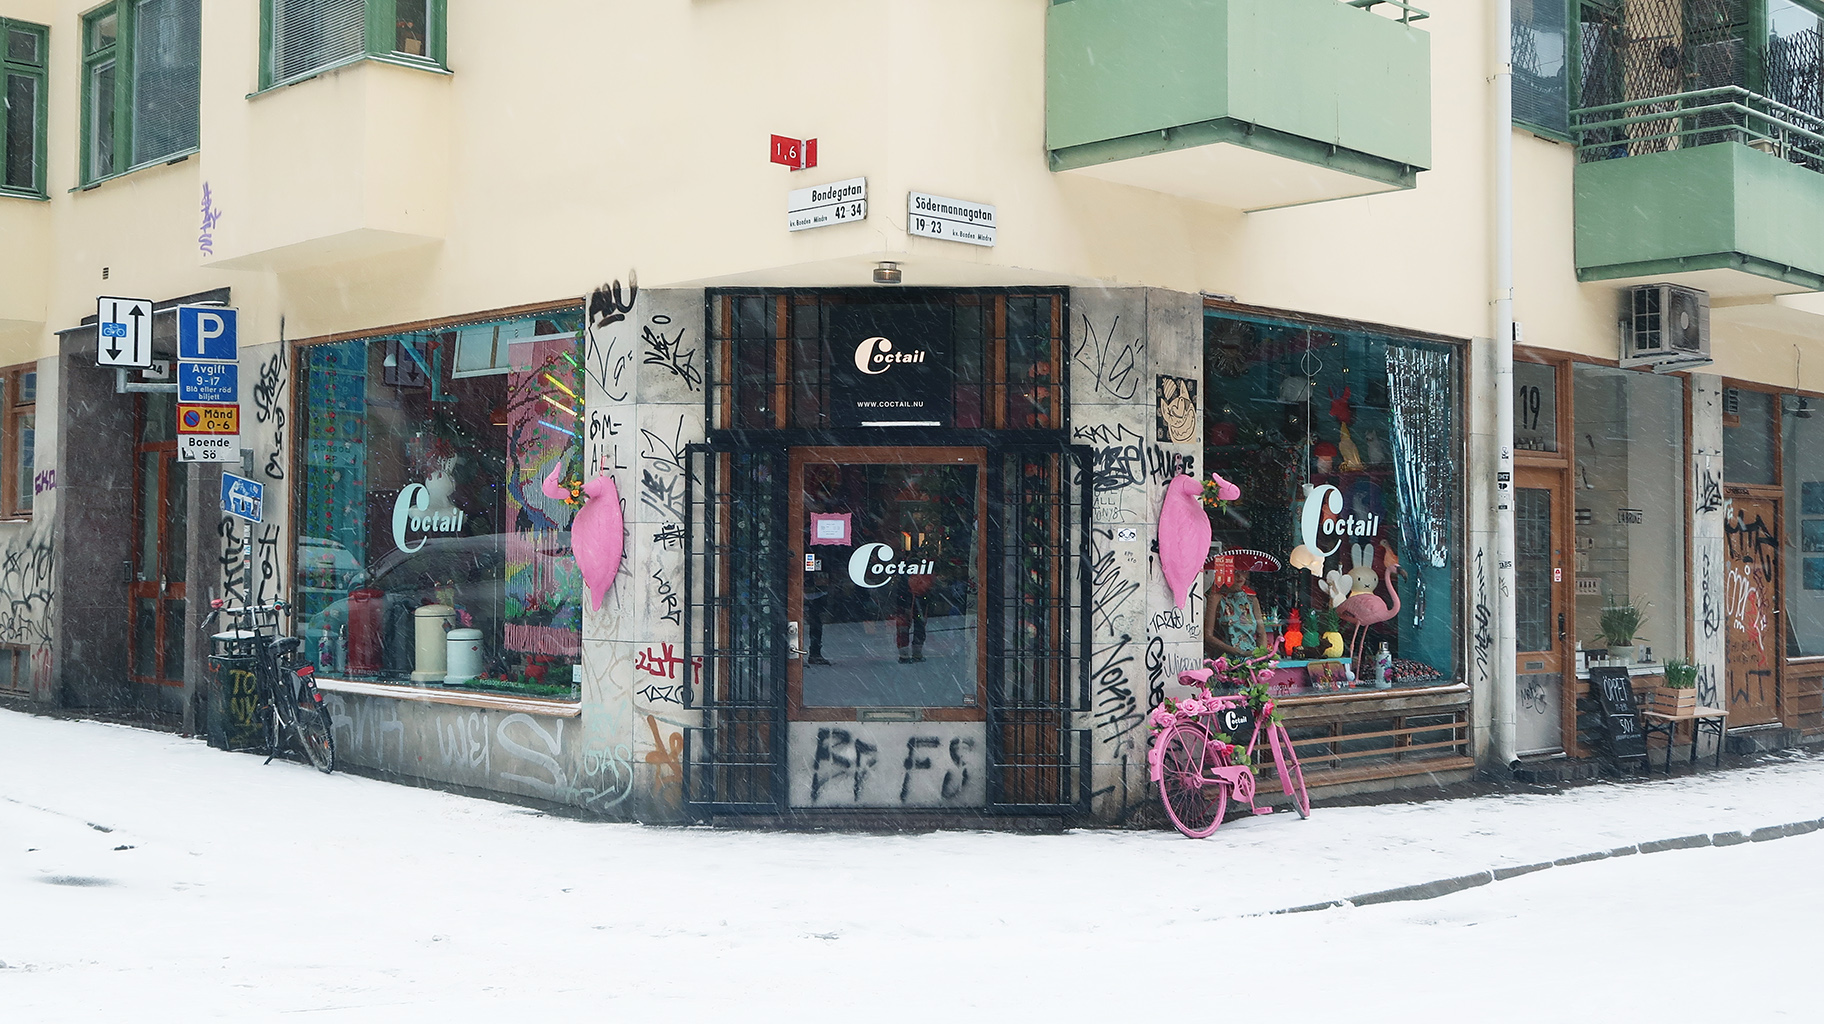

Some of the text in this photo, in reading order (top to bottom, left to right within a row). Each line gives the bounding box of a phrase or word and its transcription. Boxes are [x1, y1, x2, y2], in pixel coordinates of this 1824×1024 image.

[811, 184, 862, 202] Bondegatan
[915, 196, 993, 222] Södermannagatan
[915, 217, 942, 234] 19-23
[198, 312, 225, 355] P
[854, 336, 925, 375] Coctail
[192, 364, 226, 376] Avgift
[196, 376, 220, 386] 9-17
[198, 393, 220, 401] biljett
[204, 409, 233, 419] Månd
[1520, 385, 1541, 430] 19
[207, 420, 230, 430] 0-6
[189, 438, 230, 447] Boende
[202, 450, 216, 460] Sö
[392, 483, 464, 554] Coctail
[1301, 484, 1379, 557] Coctail
[848, 542, 934, 588] Coctail
[1225, 710, 1248, 731] Coctail
